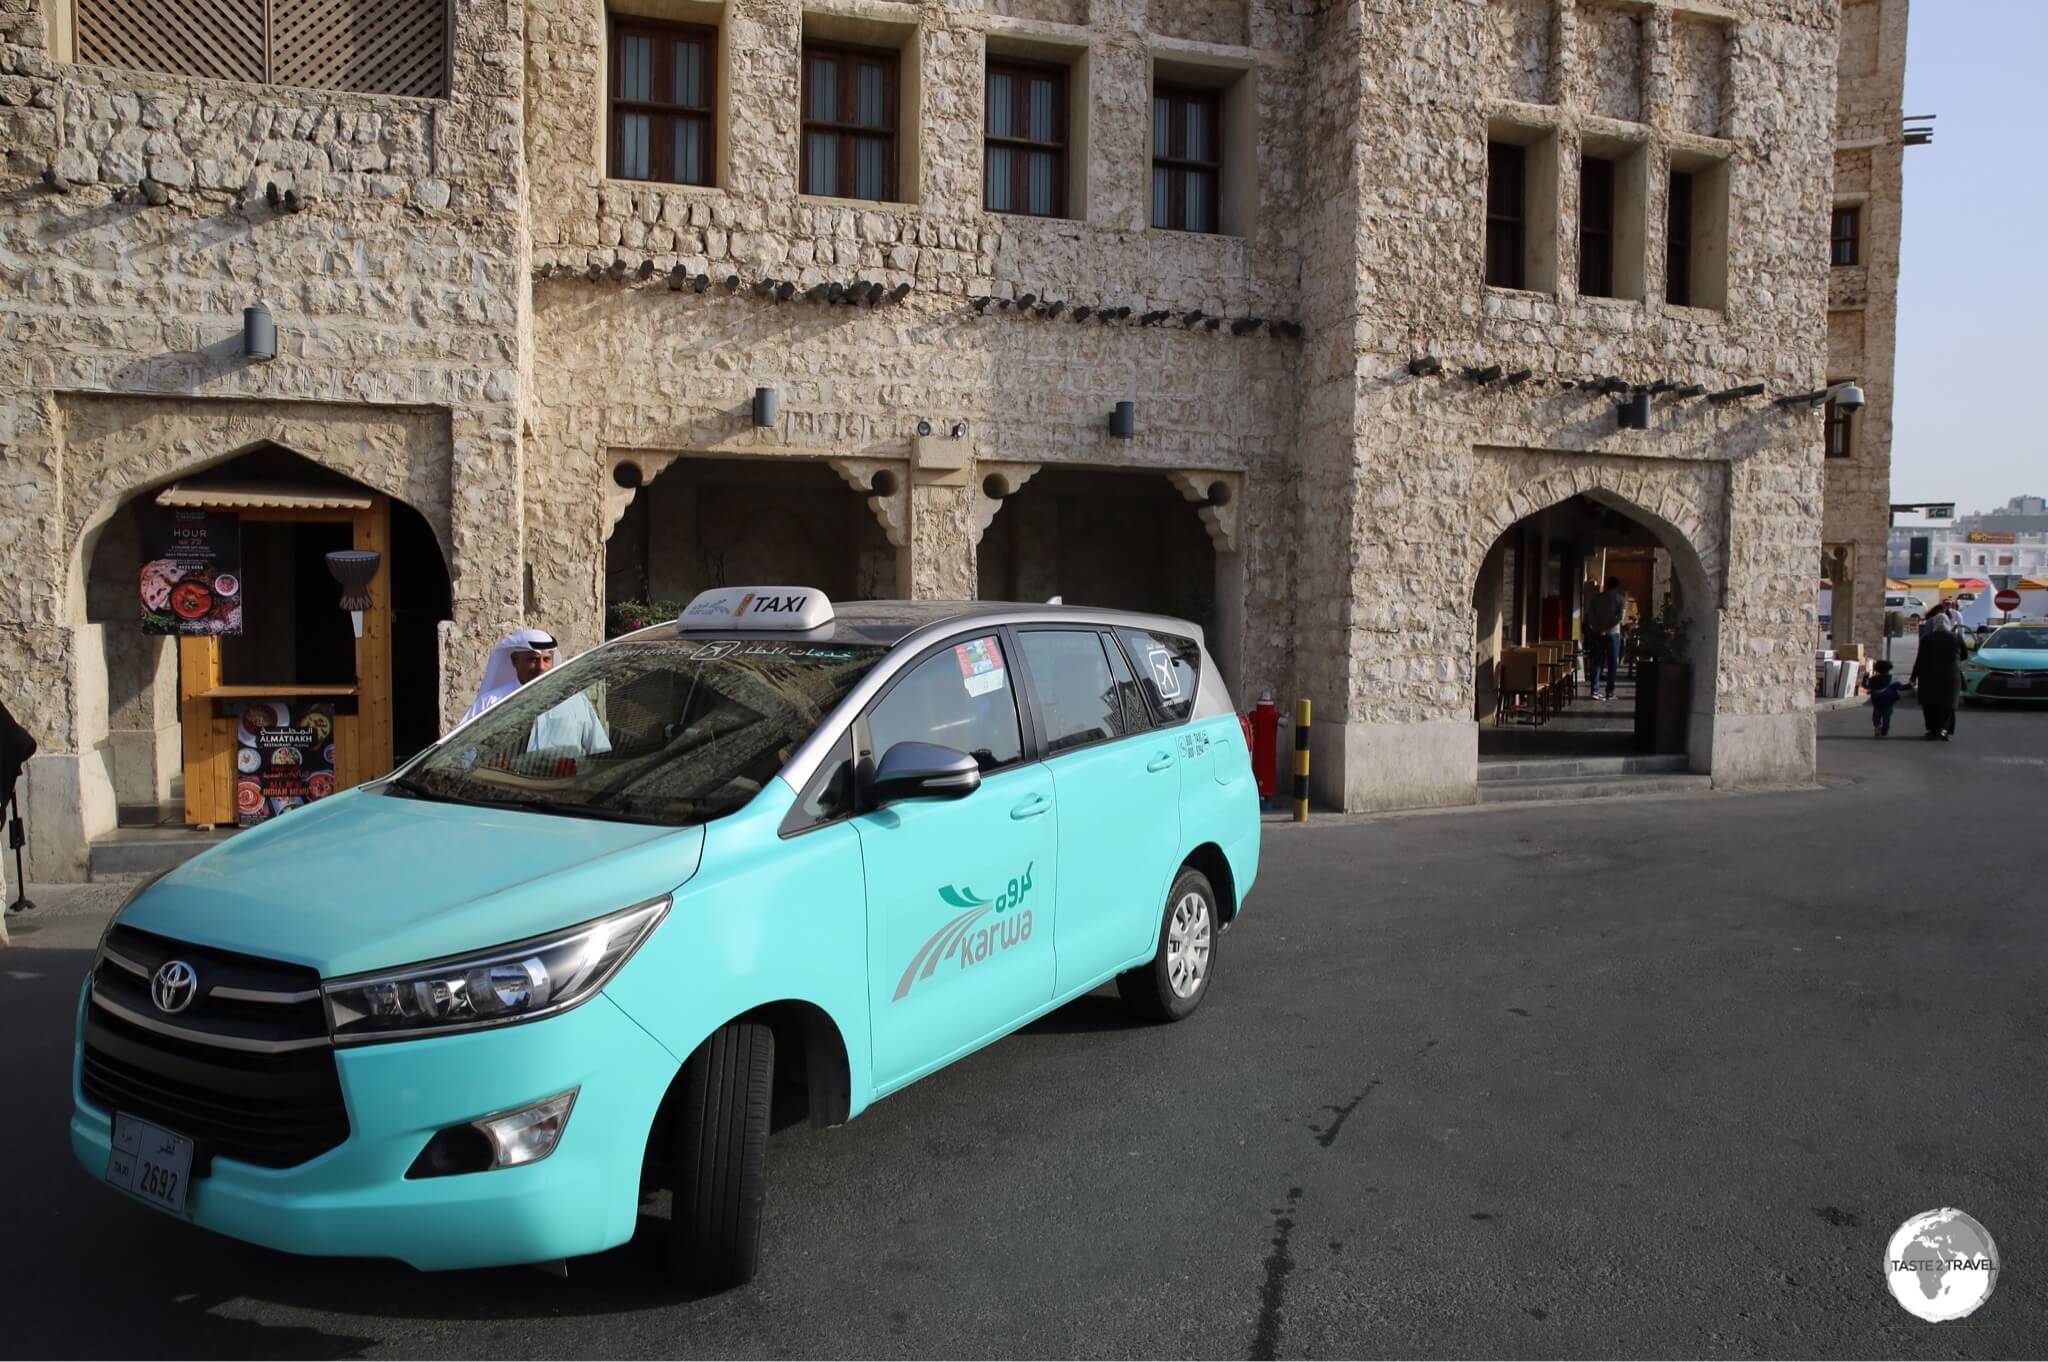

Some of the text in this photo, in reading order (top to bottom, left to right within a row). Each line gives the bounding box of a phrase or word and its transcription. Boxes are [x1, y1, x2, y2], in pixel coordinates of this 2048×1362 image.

[173, 528, 207, 537] HOUR
[753, 596, 808, 613] TAXI
[260, 735, 312, 743] ALMATBAKH
[264, 788, 287, 796] INDIAN
[995, 860, 1034, 913] كروه
[140, 1161, 178, 1203] 2692
